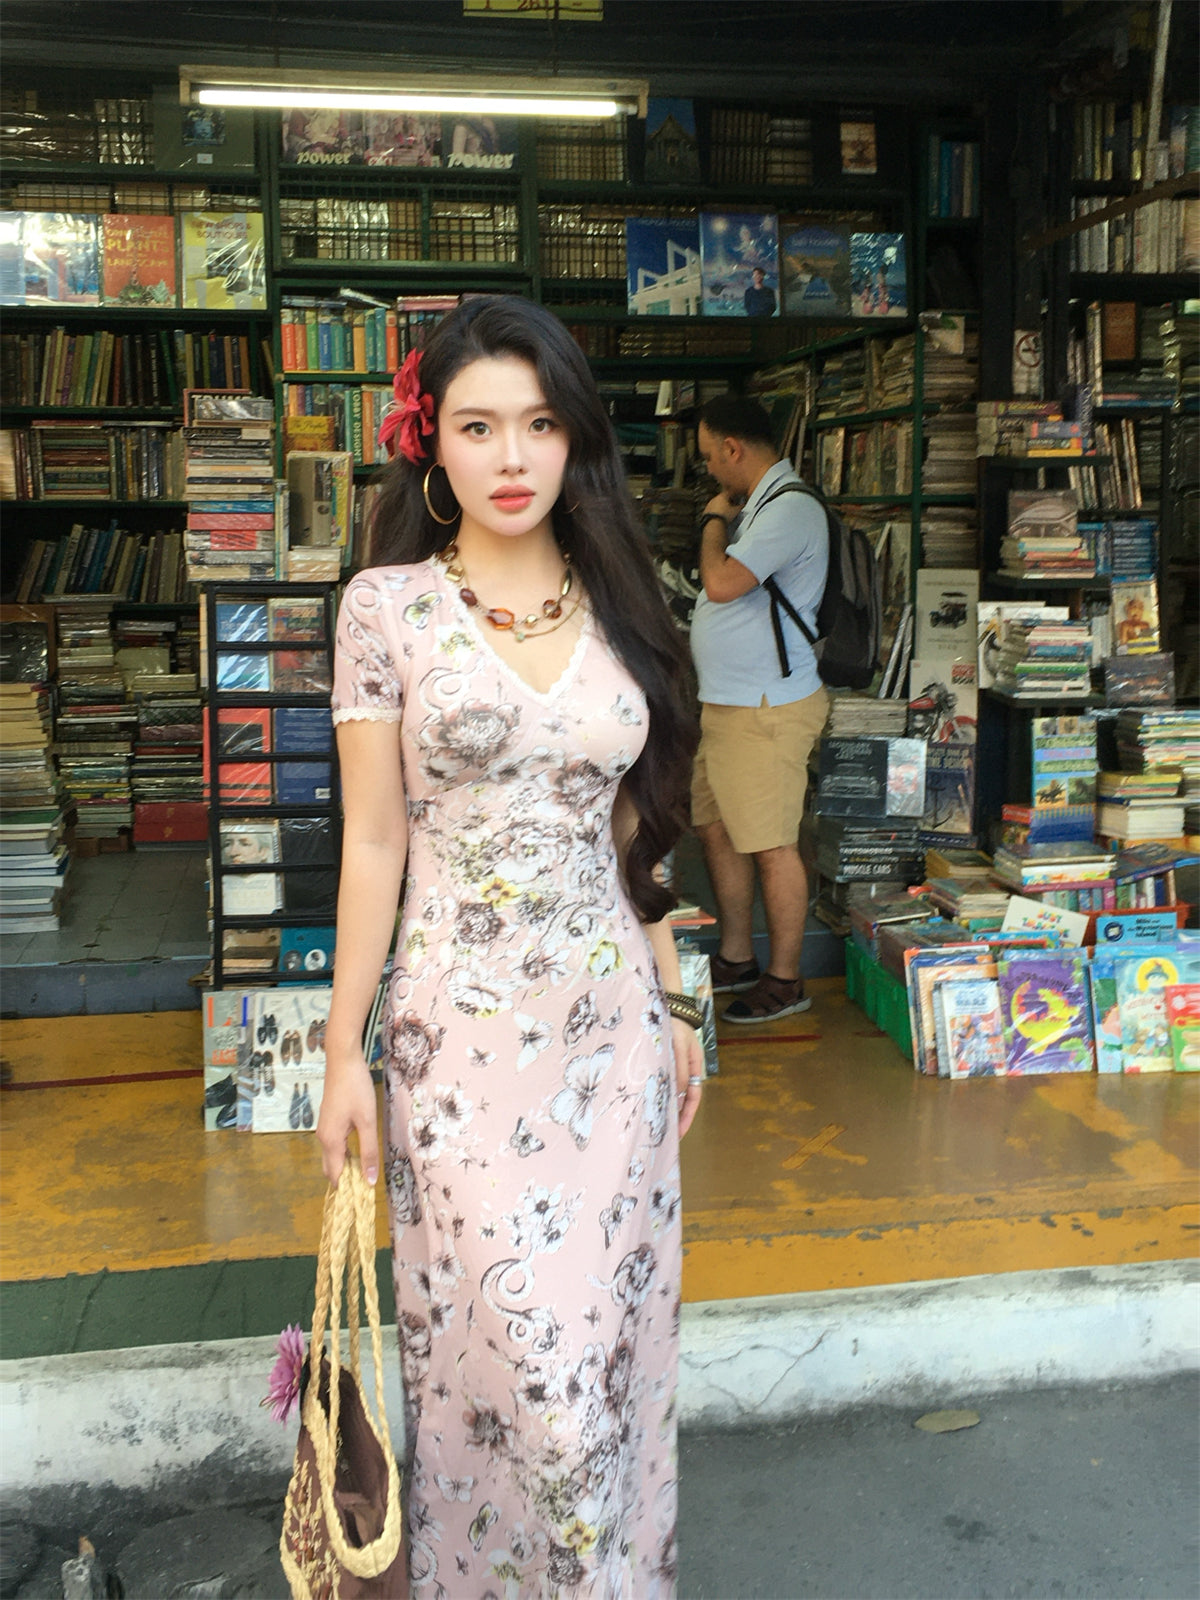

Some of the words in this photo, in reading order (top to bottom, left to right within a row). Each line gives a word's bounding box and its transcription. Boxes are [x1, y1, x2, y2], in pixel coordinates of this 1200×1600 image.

[296, 151, 353, 165] power
[447, 152, 514, 169] power
[352, 389, 361, 418] LOBBY
[353, 423, 362, 456] DESIGN
[1037, 908, 1063, 924] JUST
